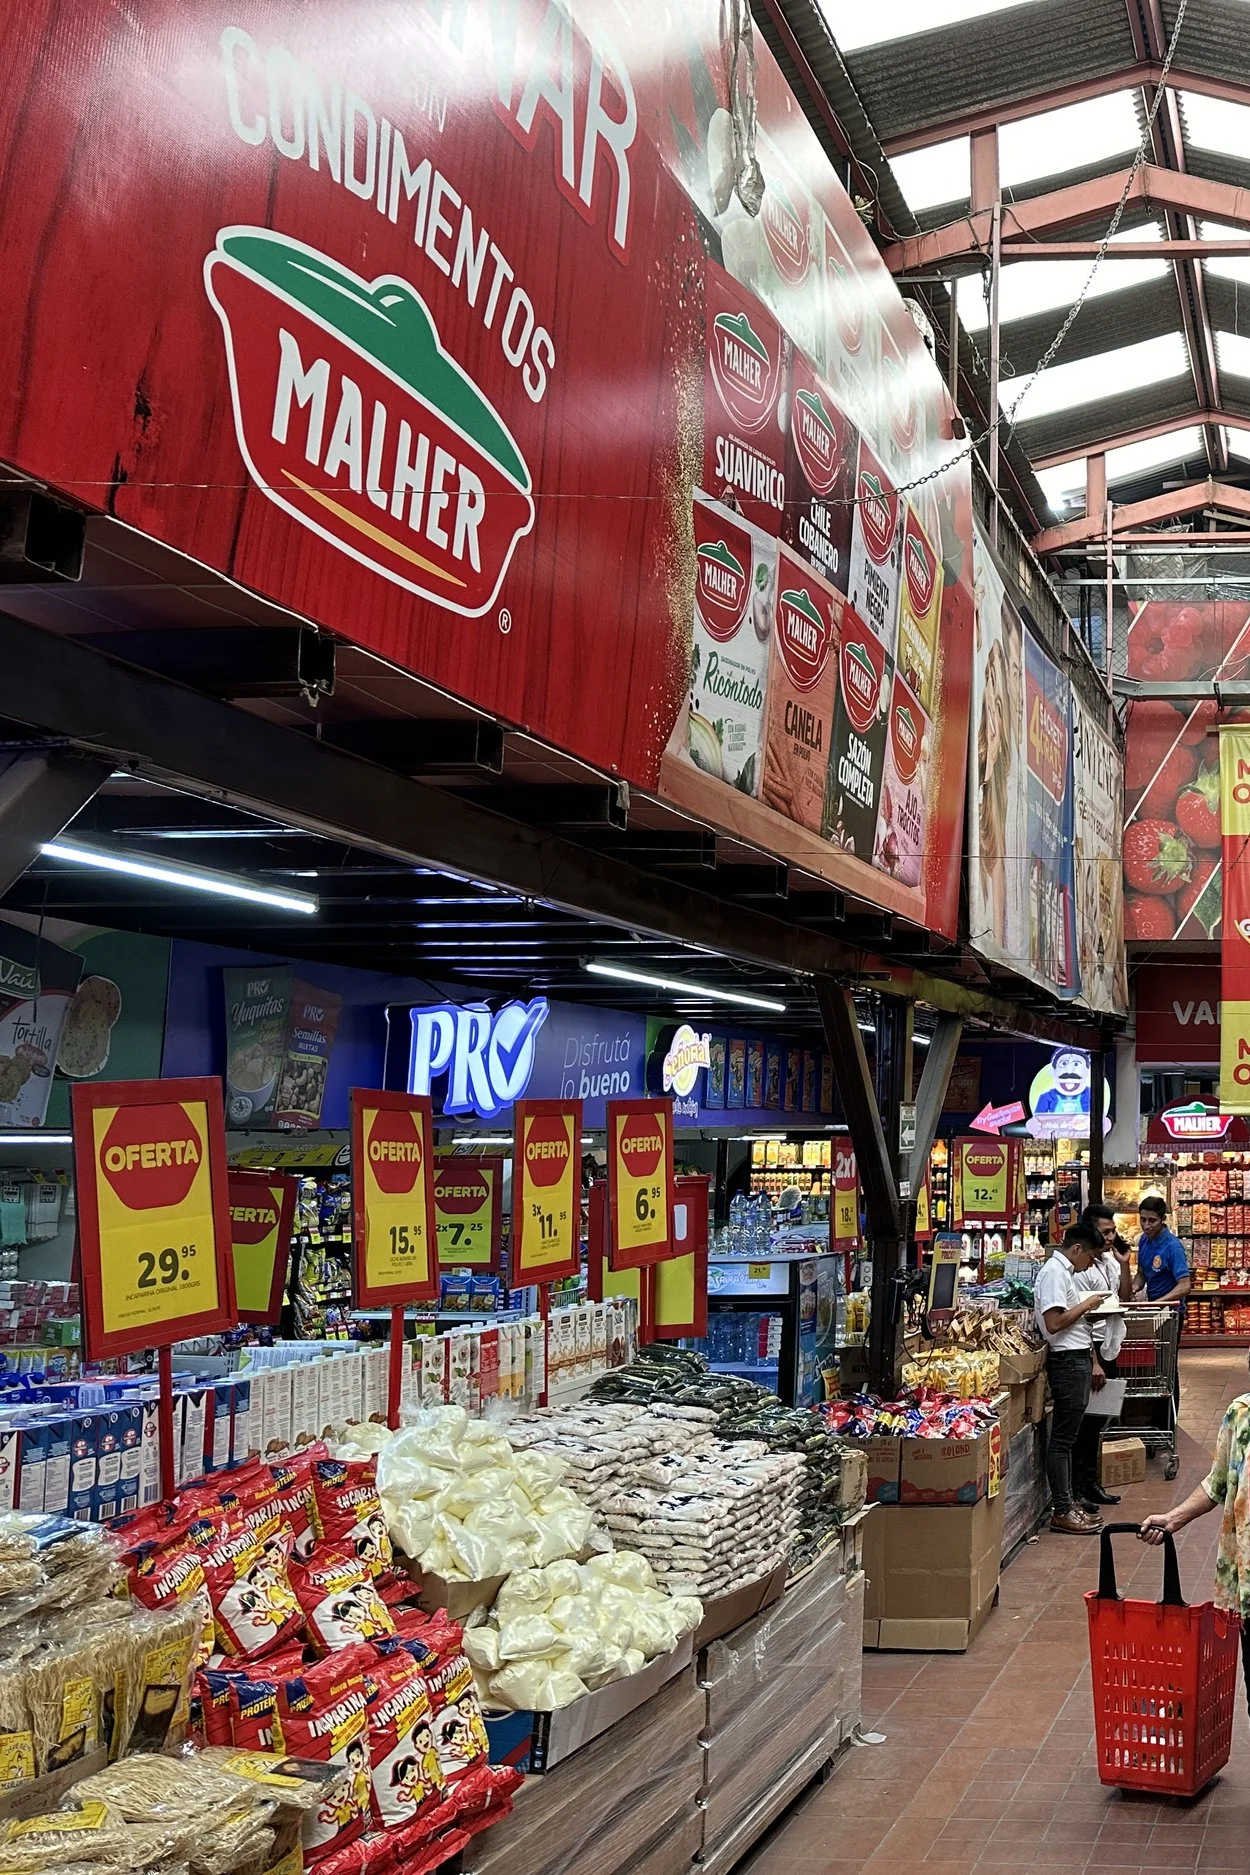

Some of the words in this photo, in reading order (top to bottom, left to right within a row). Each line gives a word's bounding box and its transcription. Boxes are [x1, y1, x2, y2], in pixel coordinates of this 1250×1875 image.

[221, 27, 555, 403] CONDIMENTOS
[724, 336, 761, 390] MALHER
[272, 328, 486, 573] MALHER
[802, 408, 830, 460] MALHER
[716, 436, 785, 511] SUAVIRICO
[810, 497, 832, 538] CHILE
[799, 515, 838, 574] COBANERO
[704, 562, 738, 600] MALHER
[863, 558, 890, 609] PIMIENTA
[865, 593, 886, 629] NEGRA
[787, 610, 818, 654] MALHER
[849, 662, 872, 700] MALHER
[784, 700, 823, 752] CANELA
[847, 732, 872, 776] SAZÓN
[838, 756, 873, 809] COMPLETA
[231, 996, 285, 1031] Yuquitas
[293, 1026, 327, 1044] Semillas
[564, 1031, 631, 1069] Disfrutá
[579, 1069, 630, 1099] bueno
[1173, 1116, 1221, 1132] MALHER
[105, 1139, 199, 1172] OFERTA
[370, 1140, 421, 1162] OFERTA
[527, 1141, 568, 1160] OFERTA
[622, 1136, 663, 1154] OFERTA
[967, 1155, 1003, 1165] OFERTA
[836, 1152, 857, 1179] 2x1
[434, 1186, 488, 1199] OFERTA
[229, 1207, 276, 1224] FERTA
[126, 1290, 155, 1301] INCAPARINA
[156, 1285, 178, 1295] ORIGINAL
